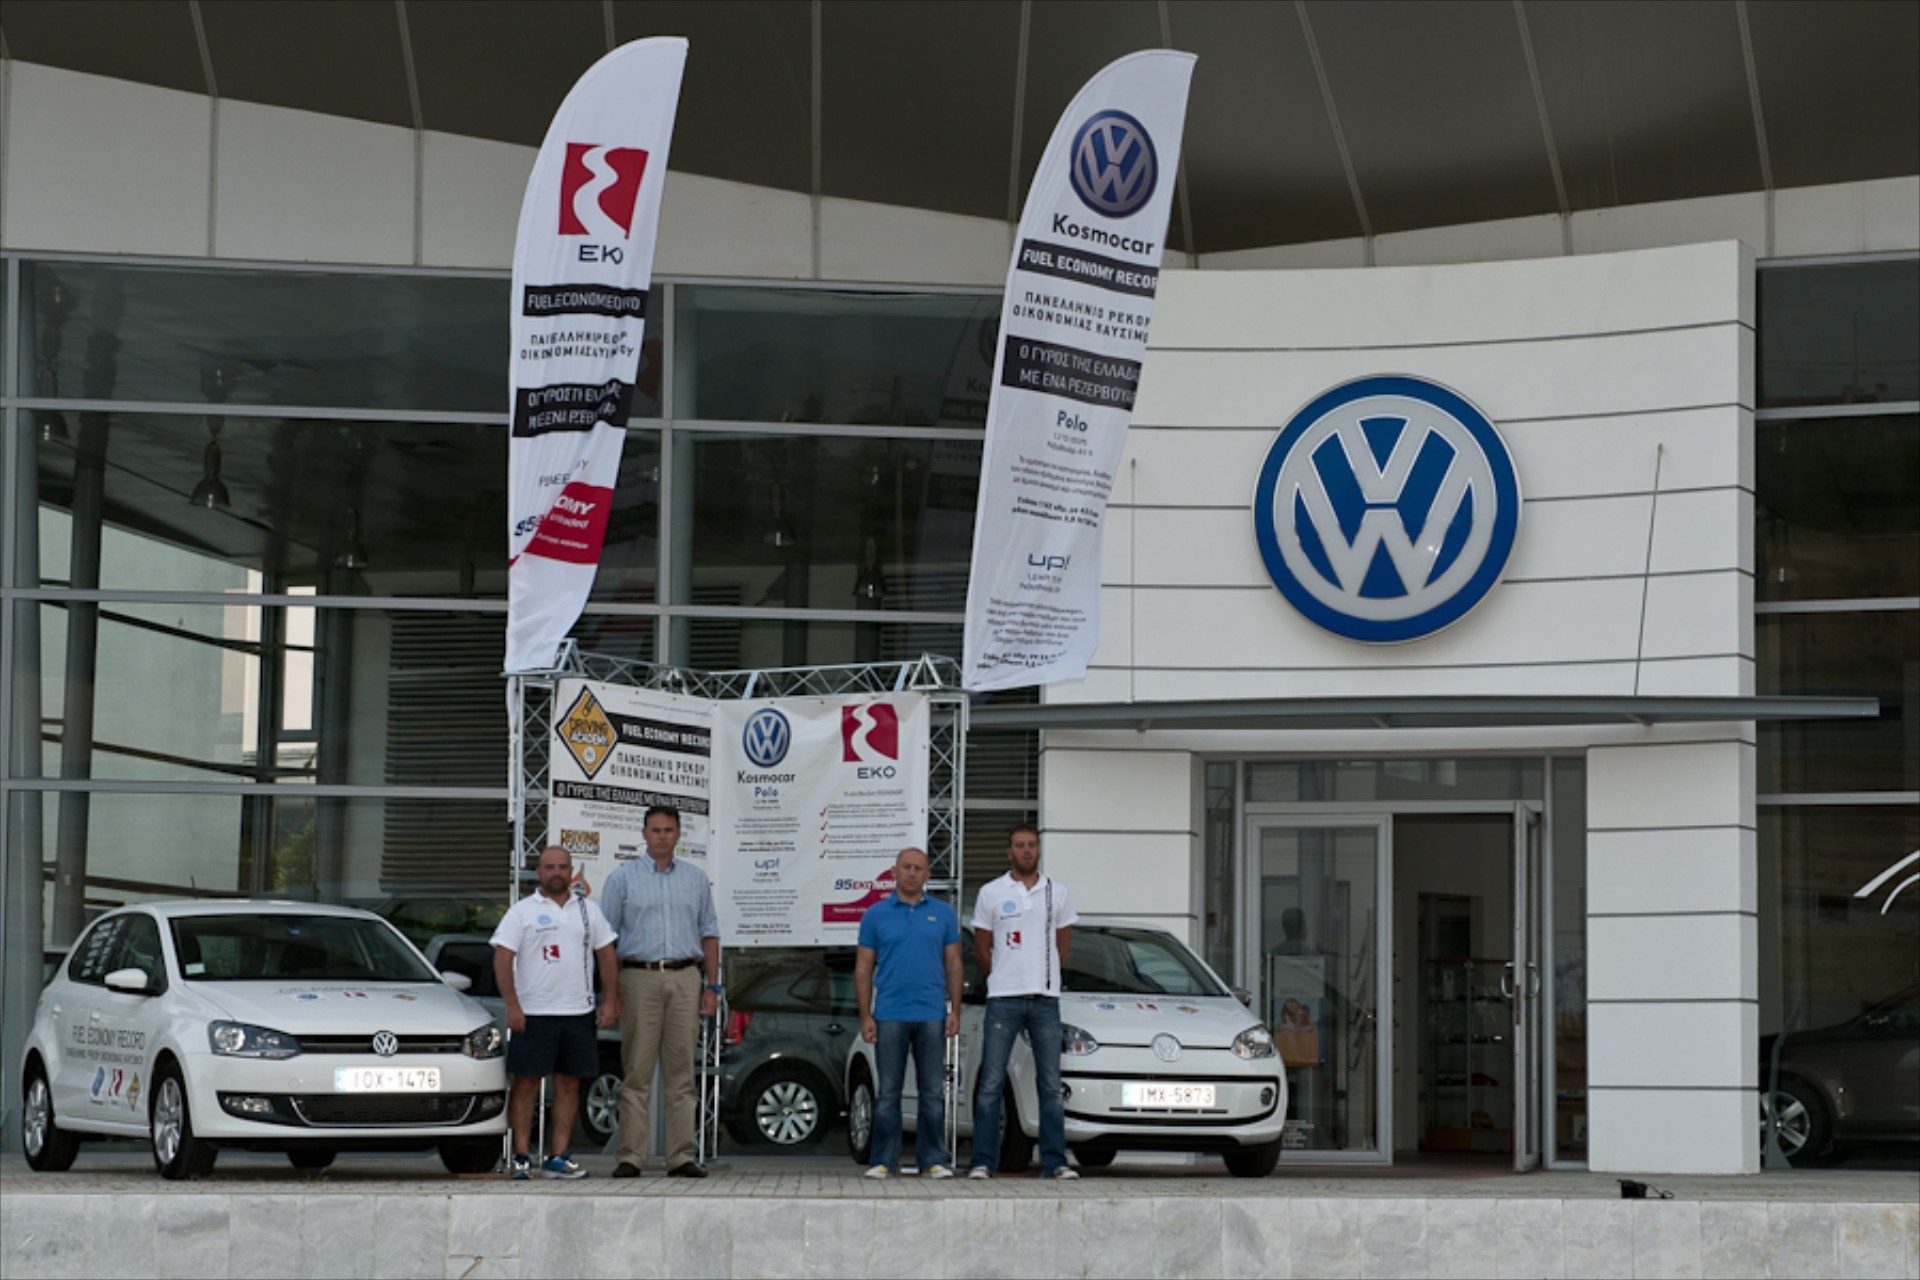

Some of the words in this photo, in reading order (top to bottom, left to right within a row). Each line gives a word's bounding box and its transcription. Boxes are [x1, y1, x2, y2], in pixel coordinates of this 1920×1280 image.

[1052, 213, 1155, 255] Kosmocar
[1022, 249, 1055, 268] FUEL
[1057, 255, 1115, 281] ECONOMY
[1025, 291, 1104, 319] ΠΑΝΕΛΛΗΝΙΟ
[1012, 304, 1093, 332] ΟΙΚΟΝΟΜΙΑΣ
[1032, 346, 1069, 367] ΓΥΡΟΣ
[1072, 354, 1091, 374] ΤΗΣ
[1020, 368, 1041, 385] ΜΕ
[1043, 372, 1066, 390] ΕΝΑ
[1056, 409, 1089, 432] Polo
[1028, 553, 1071, 571] up!
[737, 770, 796, 784] Kosmocar
[856, 765, 897, 779] EKO
